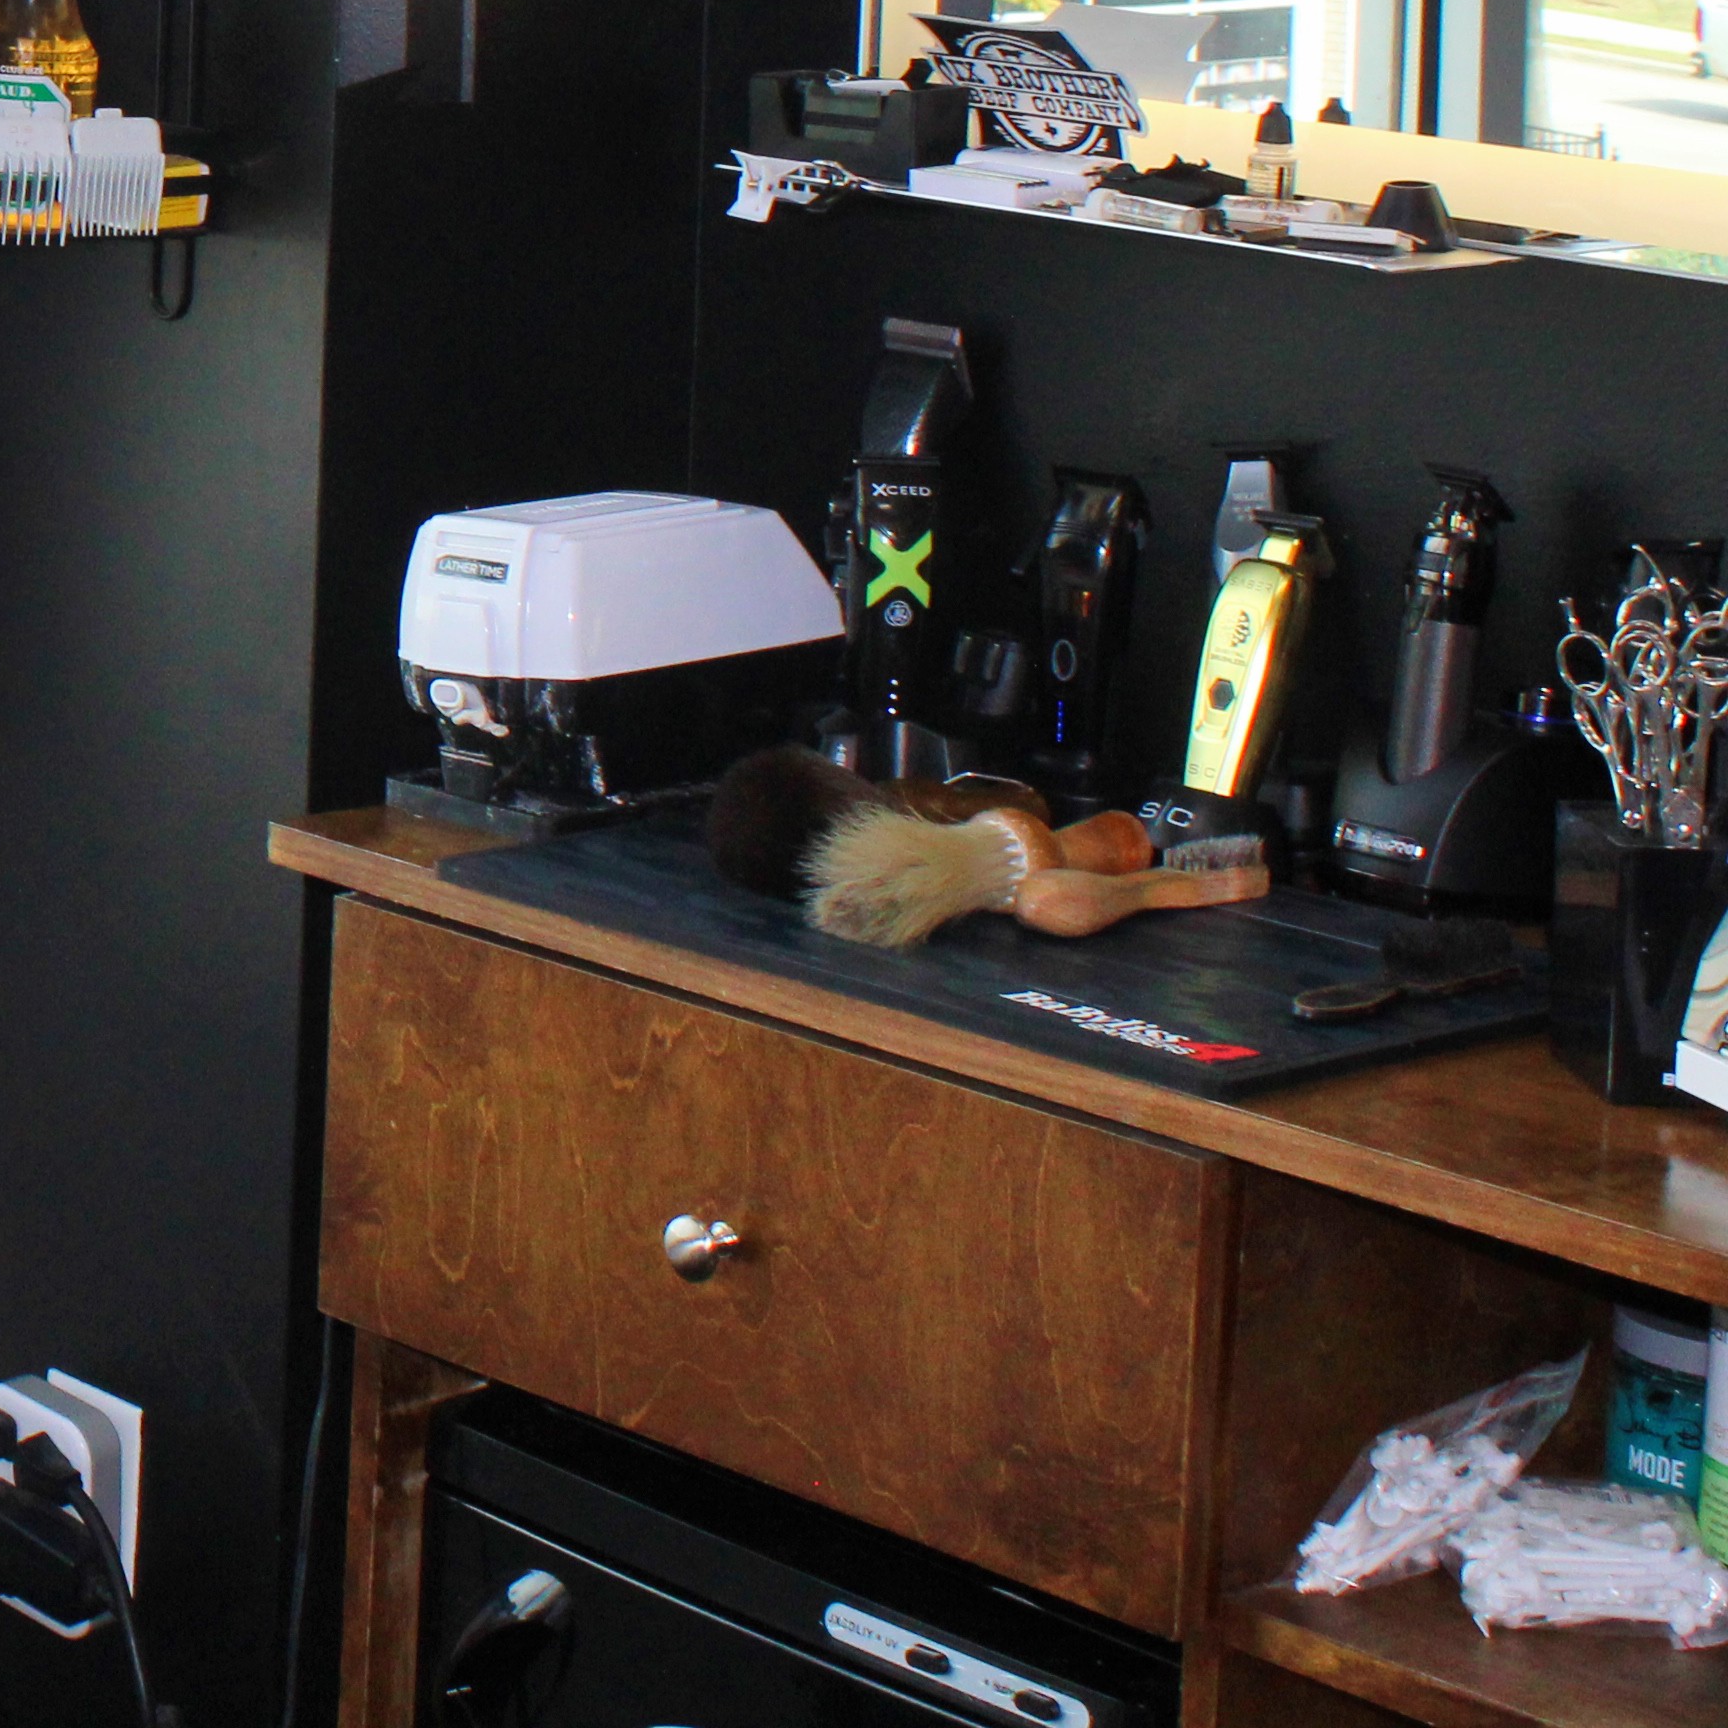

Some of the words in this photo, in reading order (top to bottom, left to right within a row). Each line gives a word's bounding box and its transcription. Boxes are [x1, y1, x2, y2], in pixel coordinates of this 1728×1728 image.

[0, 65, 22, 75] CLUB
[968, 88, 1017, 109] BEEF
[1032, 95, 1122, 123] COMPANY
[987, 63, 1141, 132] BROTHERS
[871, 482, 932, 497] XCEED
[439, 558, 477, 575] LATHER
[480, 563, 505, 579] TIME
[1628, 1444, 1686, 1490] MODE
